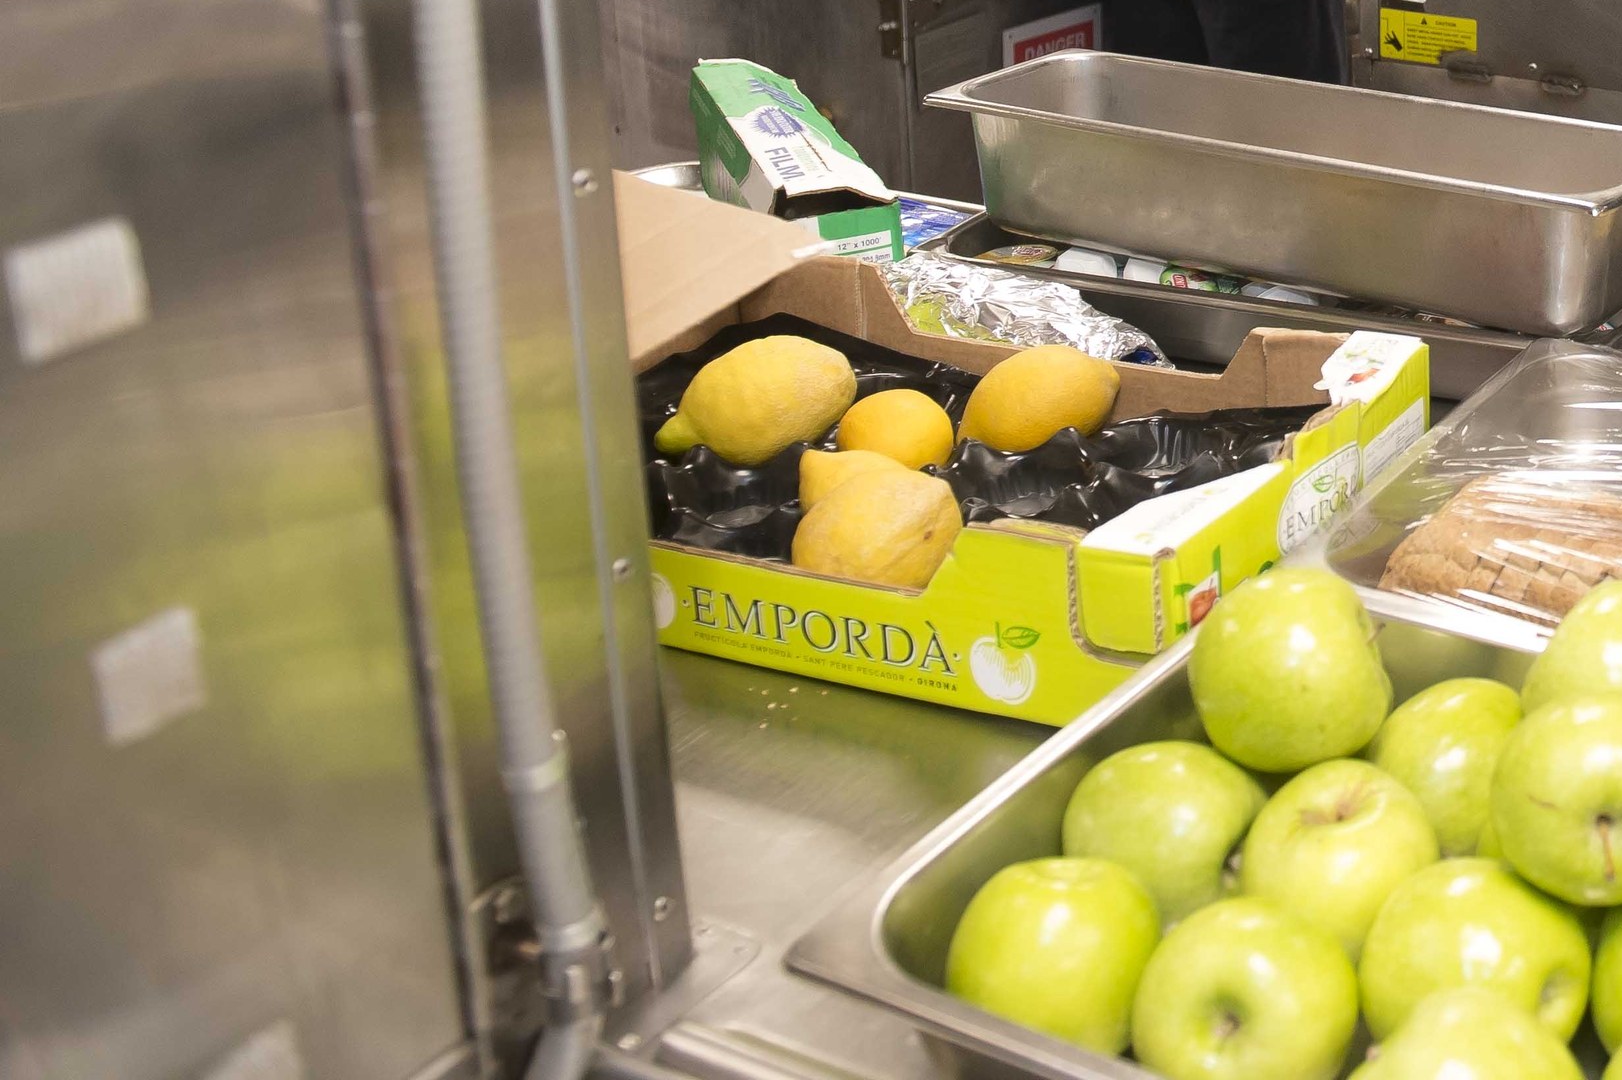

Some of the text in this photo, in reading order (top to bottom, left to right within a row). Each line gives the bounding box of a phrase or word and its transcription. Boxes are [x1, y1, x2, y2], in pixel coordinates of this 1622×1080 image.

[1025, 31, 1085, 61] DANGER
[764, 146, 806, 181] FILM
[688, 584, 957, 677] EMPORDÀ
[917, 677, 958, 693] GIRONA
